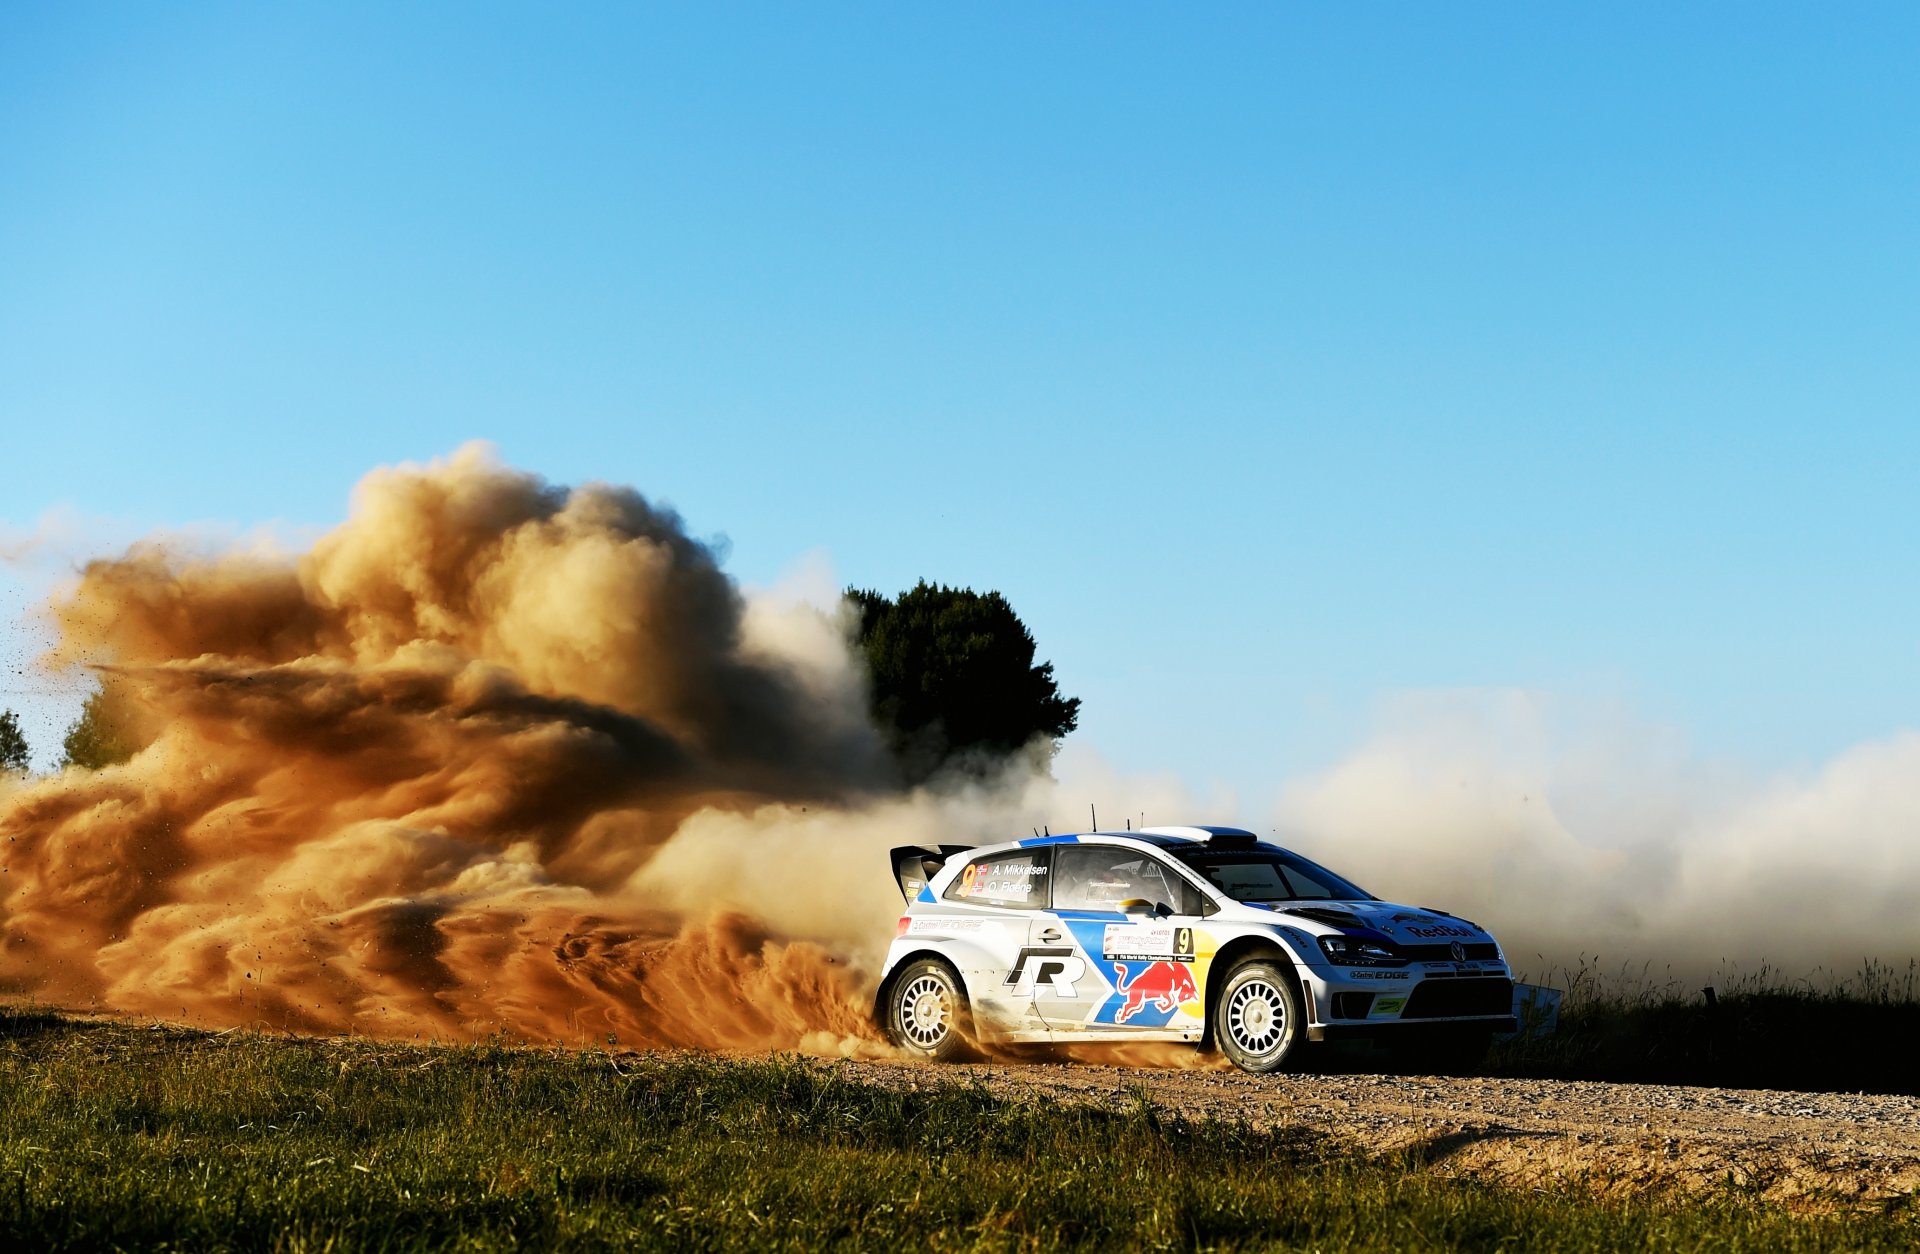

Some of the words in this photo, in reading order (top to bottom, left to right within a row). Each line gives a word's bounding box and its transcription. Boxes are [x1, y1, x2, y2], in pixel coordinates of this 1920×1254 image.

[991, 864, 1001, 876] A.
[1003, 864, 1048, 876] Mikkelsen
[961, 863, 976, 898] 9
[988, 881, 998, 893] O.
[1178, 928, 1190, 954] 9
